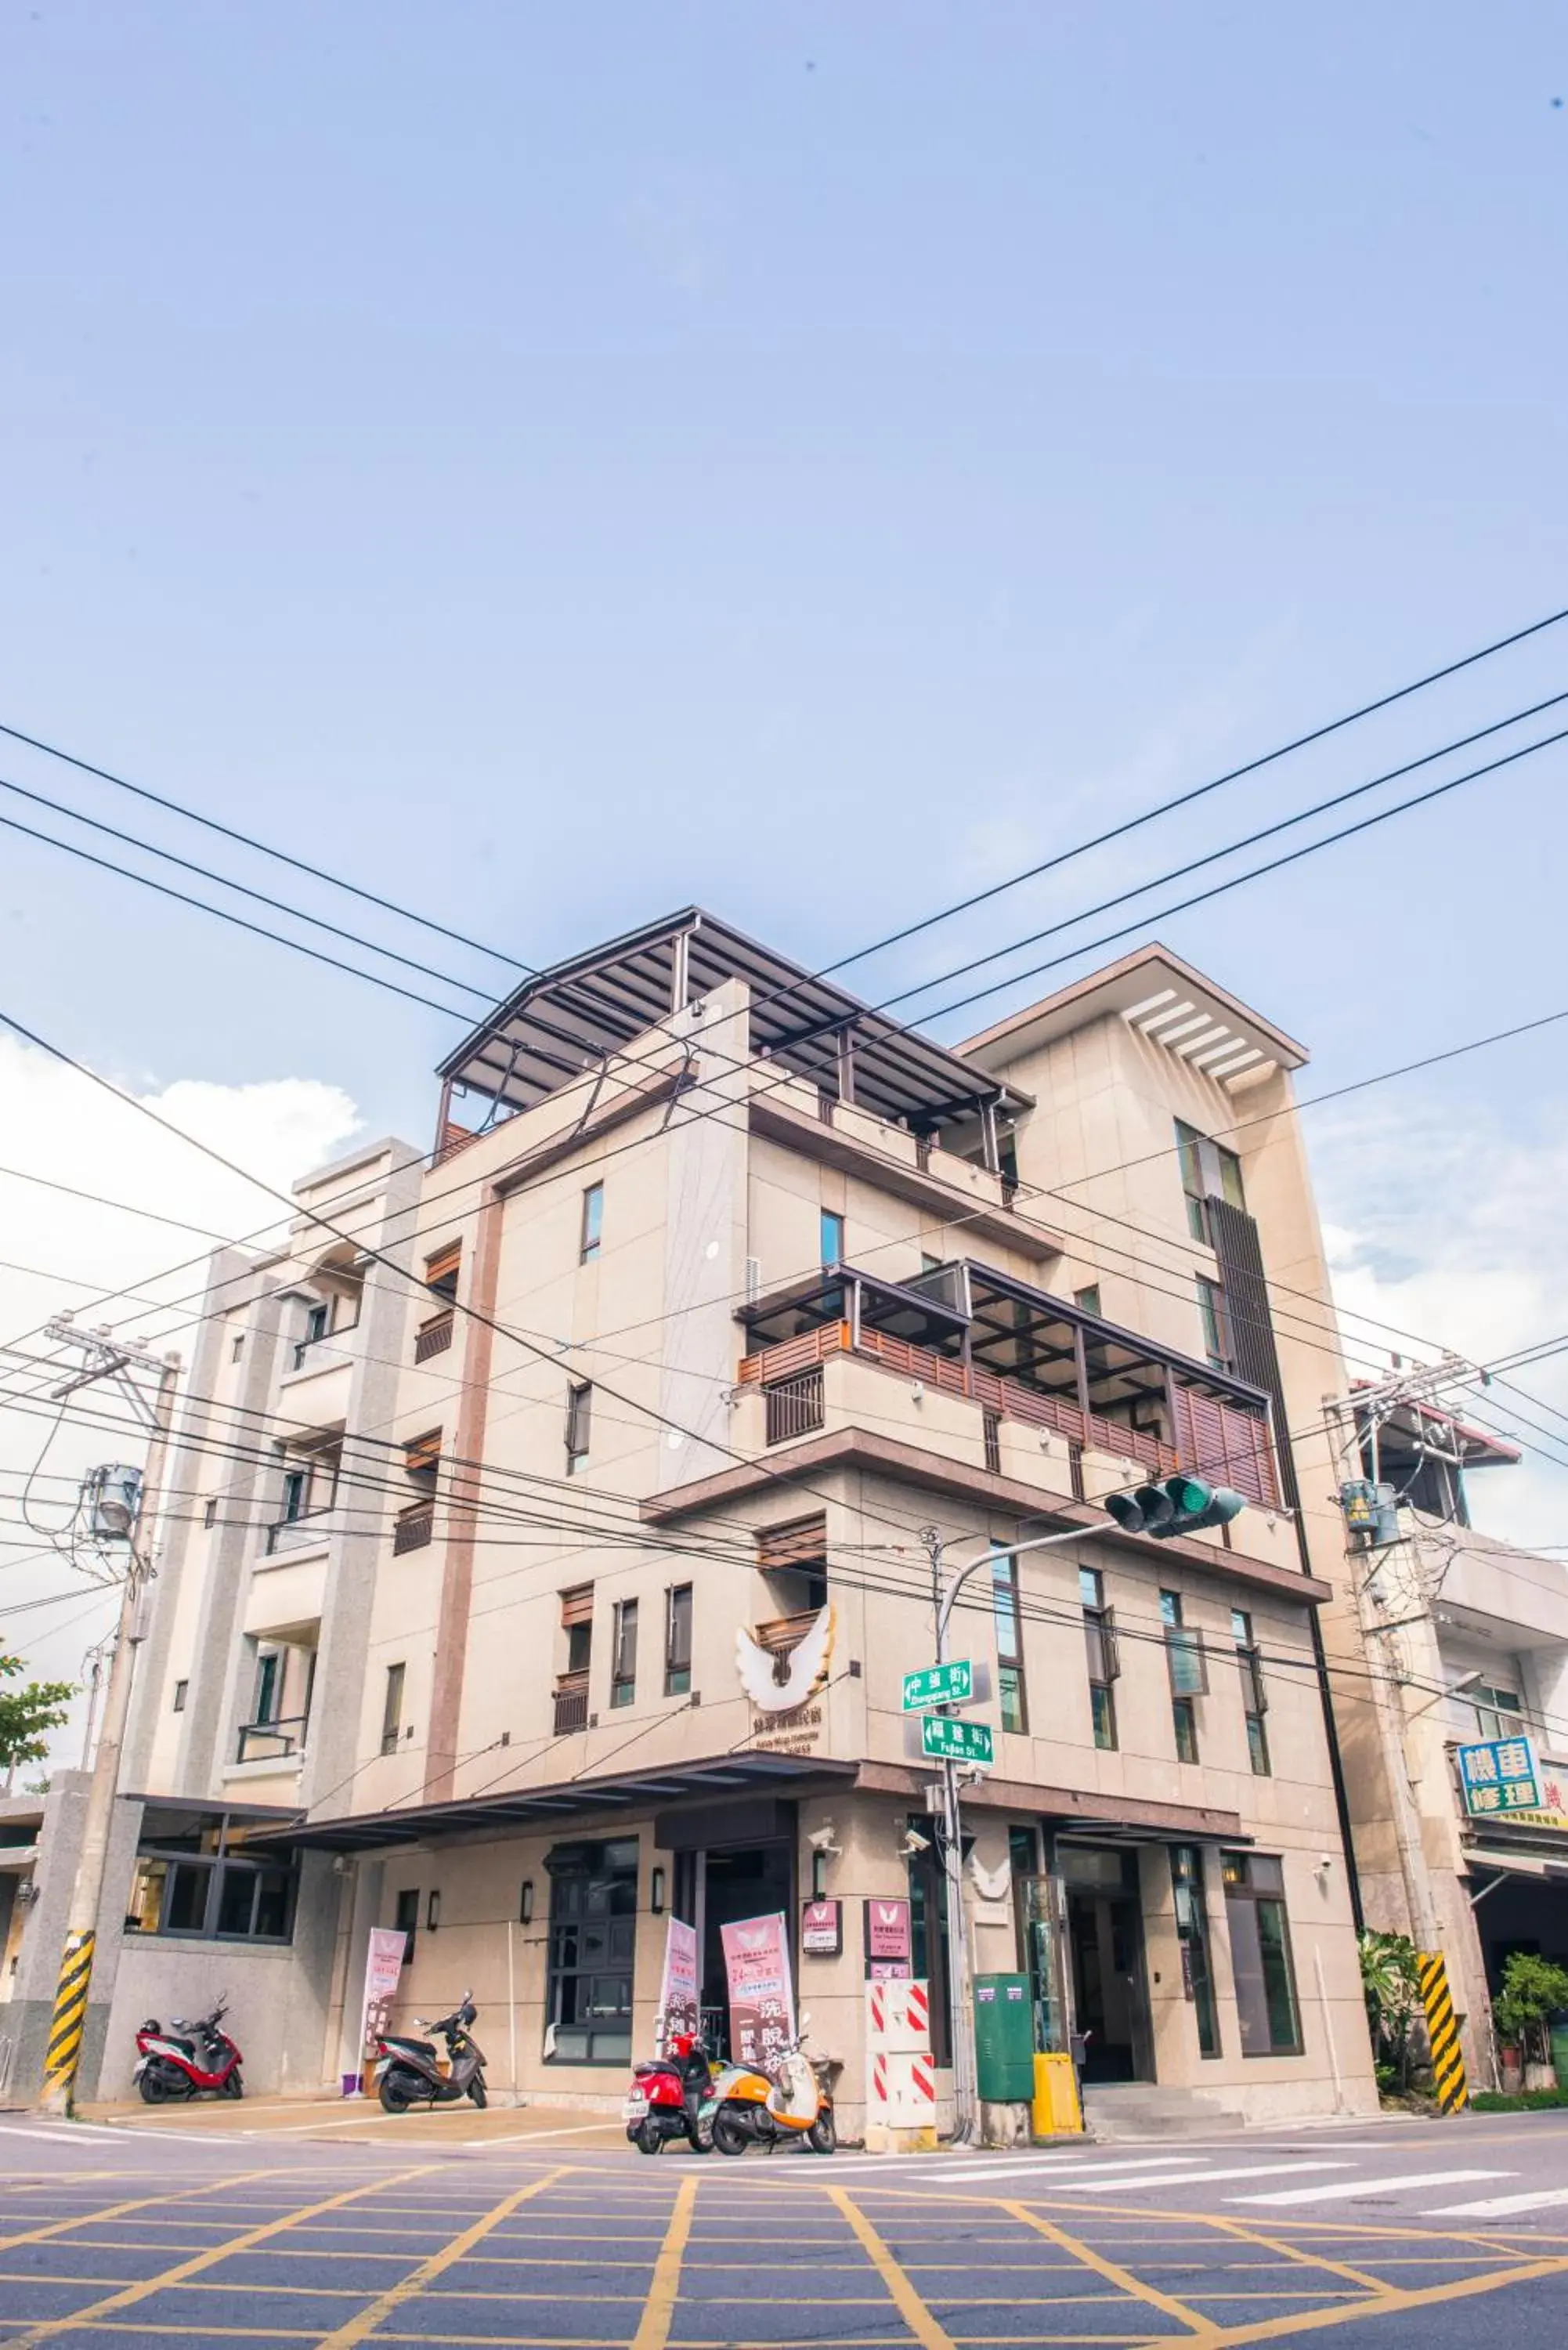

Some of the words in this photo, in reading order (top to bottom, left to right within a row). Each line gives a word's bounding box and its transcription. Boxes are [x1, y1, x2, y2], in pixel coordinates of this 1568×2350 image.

[932, 1720, 983, 1746] 福建街
[1464, 1742, 1530, 1784] 機車
[1471, 1781, 1536, 1811] 修理
